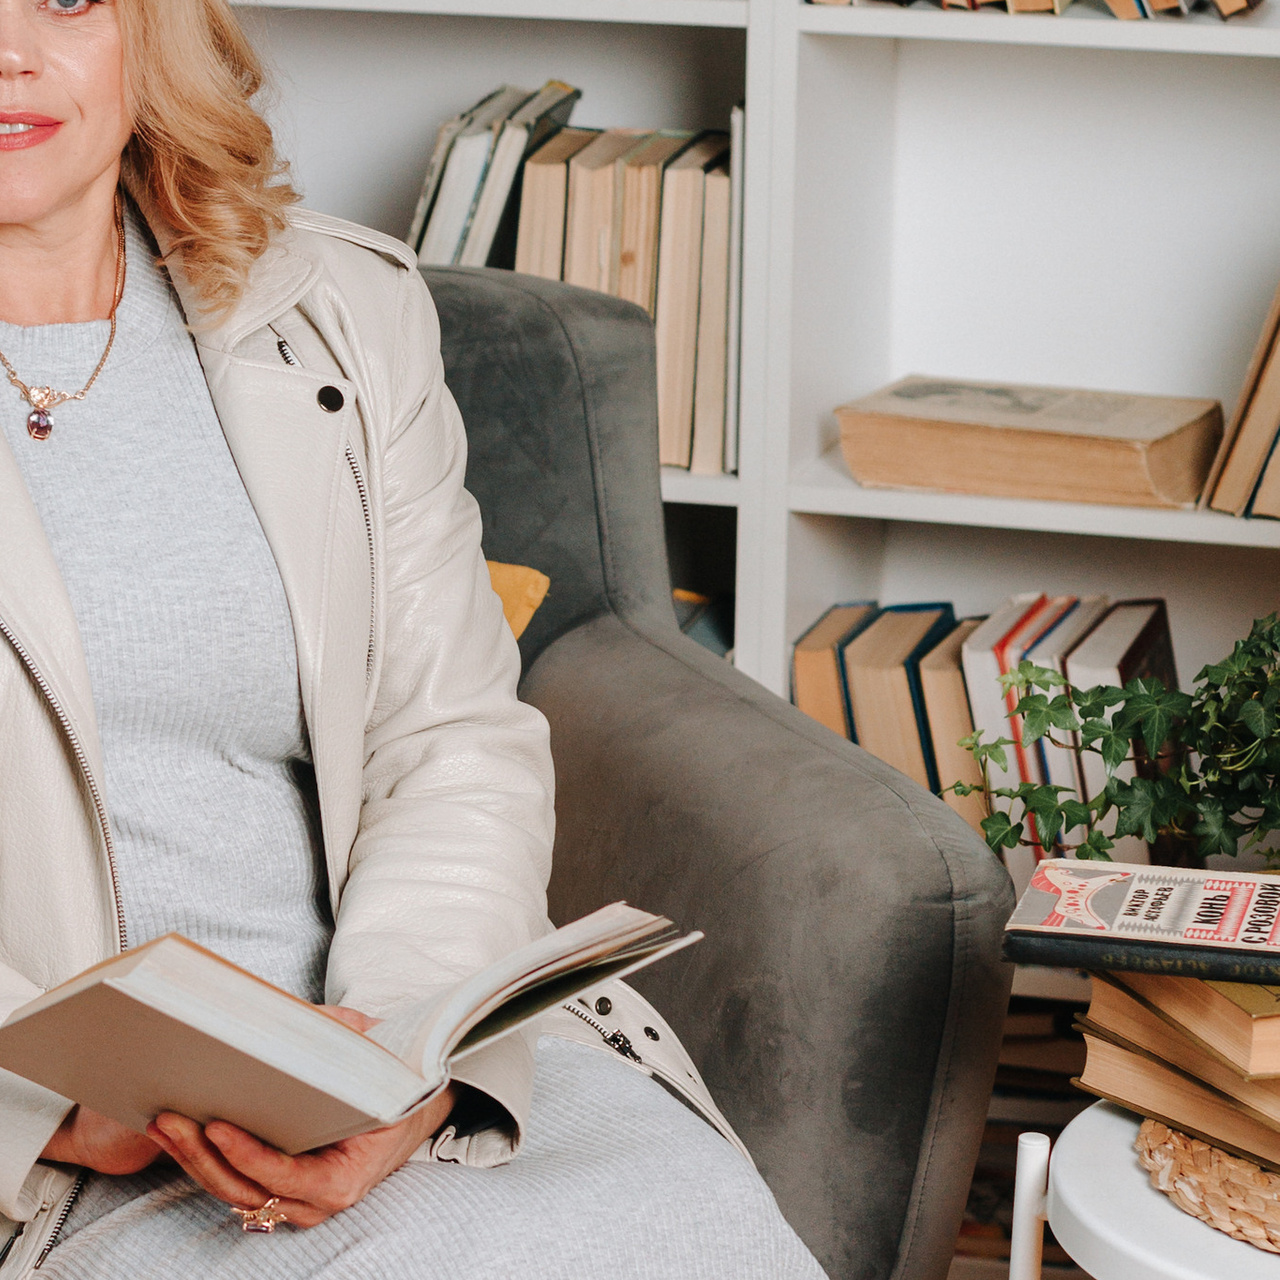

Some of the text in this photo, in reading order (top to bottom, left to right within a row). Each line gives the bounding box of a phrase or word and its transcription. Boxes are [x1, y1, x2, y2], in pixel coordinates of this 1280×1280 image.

[1123, 889, 1150, 917] ВИКТОР
[1143, 887, 1174, 922] АСТАФЬЕВ
[1192, 894, 1230, 925] КОНЬ
[1244, 883, 1280, 934] РОЗОВОЙ
[1241, 936, 1268, 944] С
